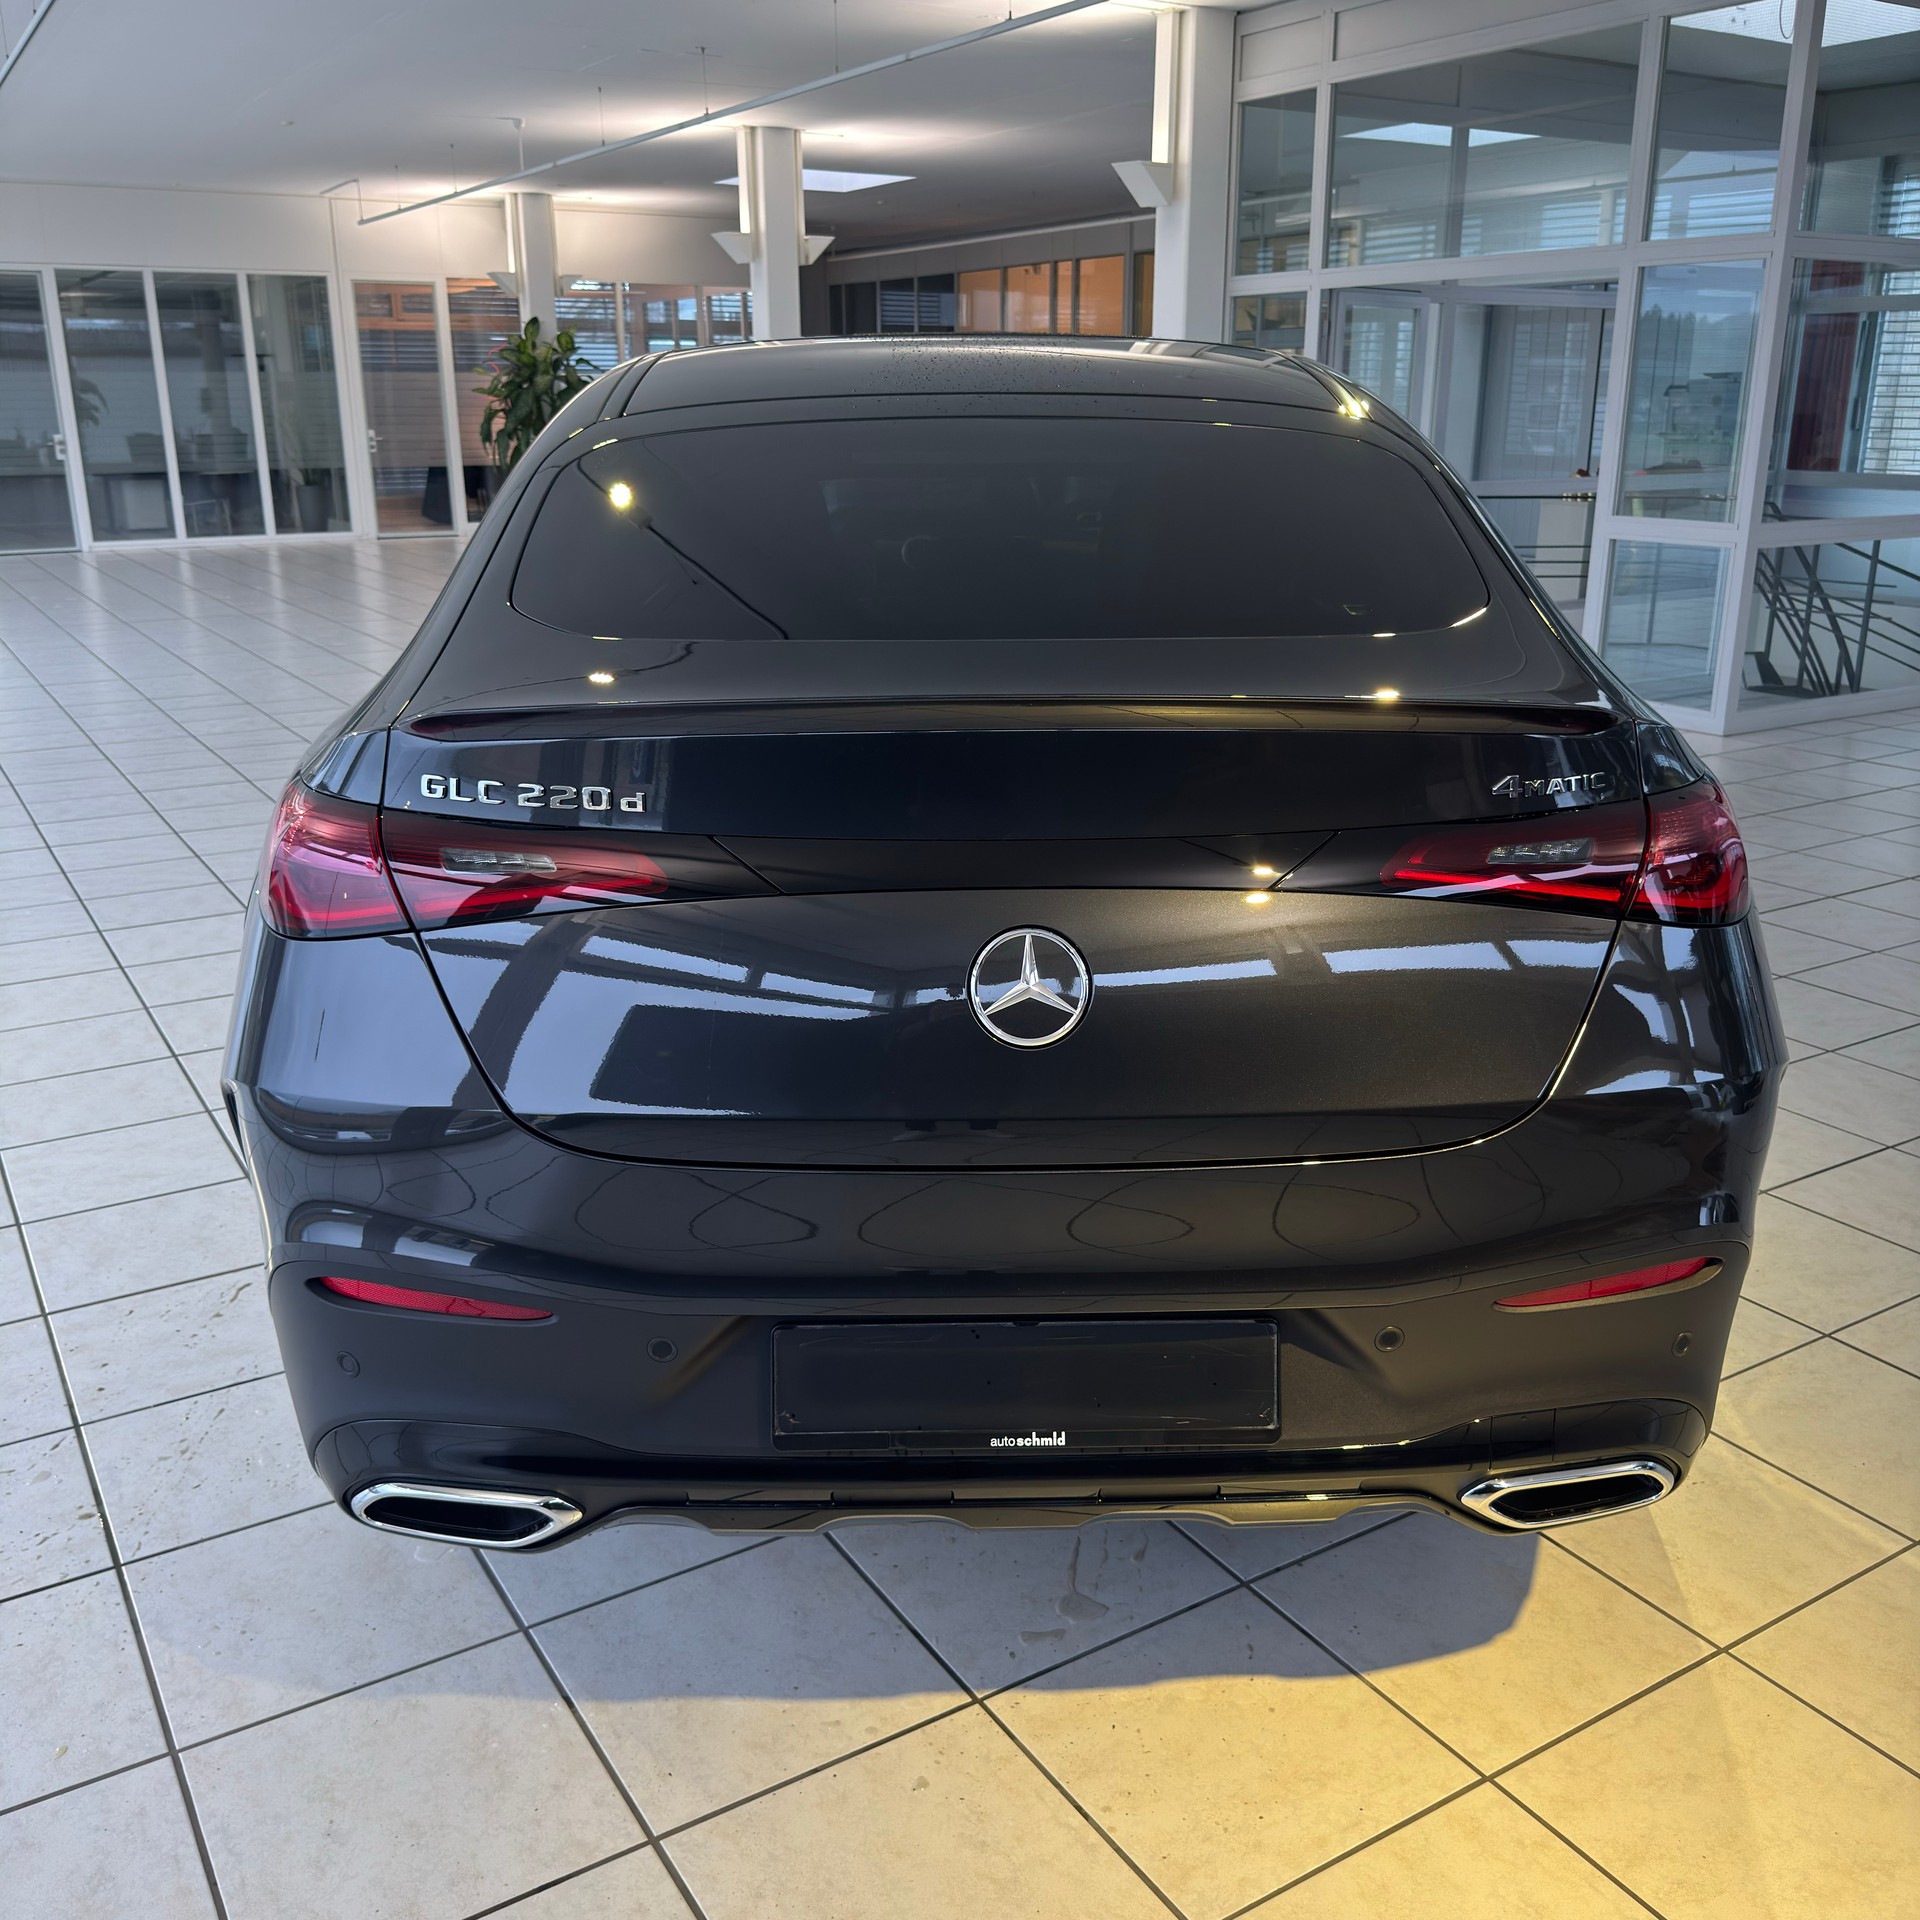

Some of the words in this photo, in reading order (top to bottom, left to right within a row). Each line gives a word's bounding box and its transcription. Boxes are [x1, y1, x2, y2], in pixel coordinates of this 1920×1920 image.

[420, 774, 504, 805] GLC
[517, 783, 612, 812] 220
[620, 792, 647, 813] d
[1491, 772, 1606, 799] 4MATIC
